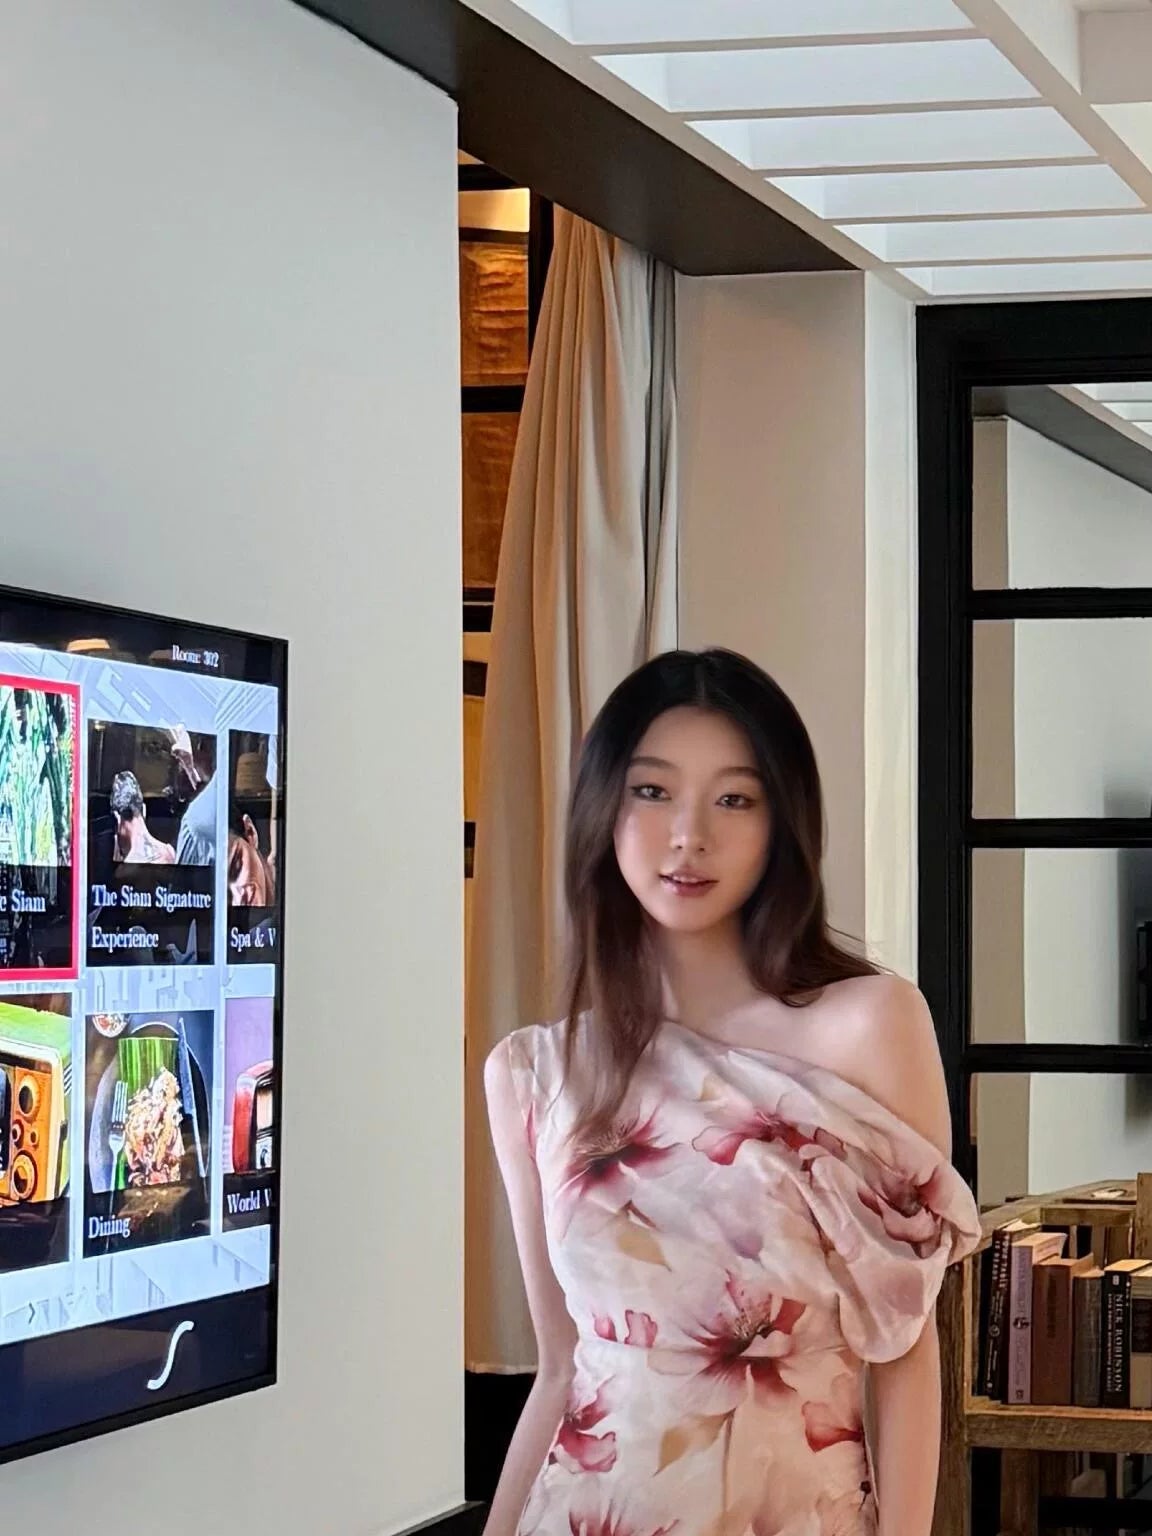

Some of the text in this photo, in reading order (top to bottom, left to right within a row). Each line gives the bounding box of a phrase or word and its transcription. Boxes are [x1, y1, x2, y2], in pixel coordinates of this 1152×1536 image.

[11, 888, 46, 913] Siam
[92, 884, 212, 913] The Siam Signature
[91, 926, 160, 953] Experience
[230, 926, 251, 952] Spa
[254, 929, 265, 948] &
[227, 1189, 261, 1214] World
[88, 1215, 131, 1239] Dining
[1113, 1293, 1123, 1392] NICK ROBINSON
